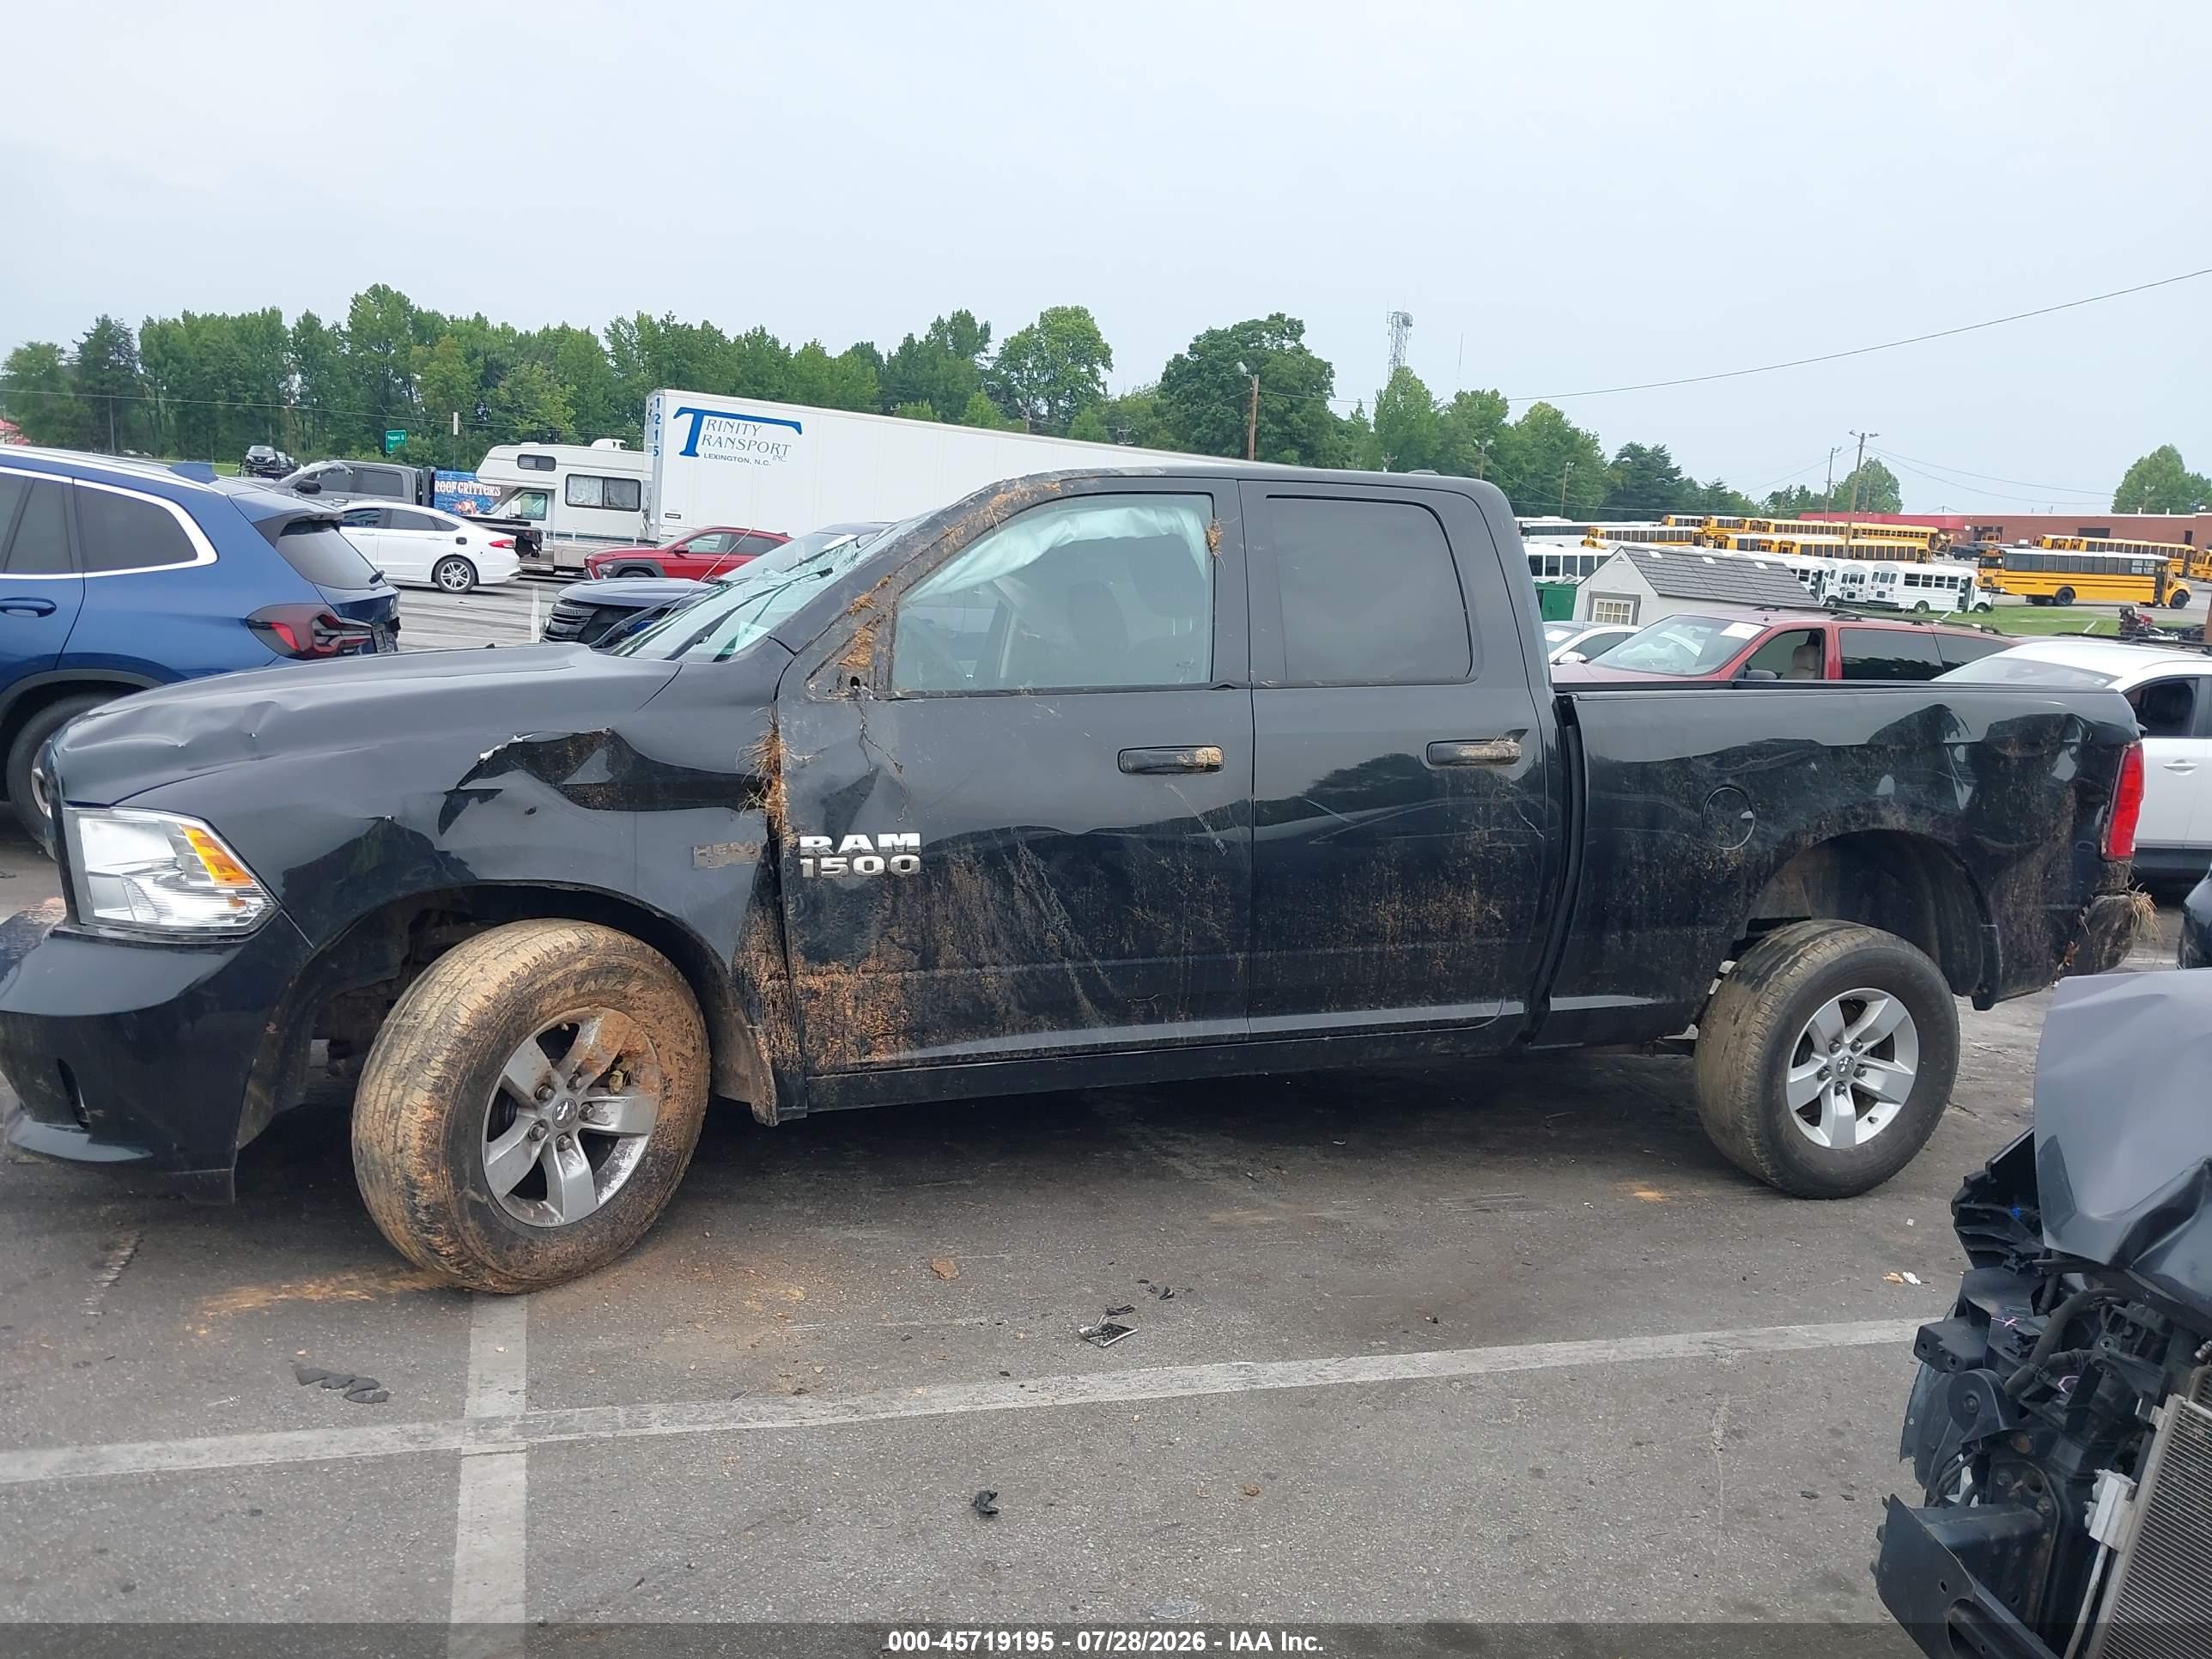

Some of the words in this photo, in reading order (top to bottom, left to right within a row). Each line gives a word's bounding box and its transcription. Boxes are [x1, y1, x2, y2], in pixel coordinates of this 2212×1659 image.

[703, 453, 752, 465] LEXINGTON,
[799, 833, 921, 855] RAM
[799, 855, 921, 878] 1500
